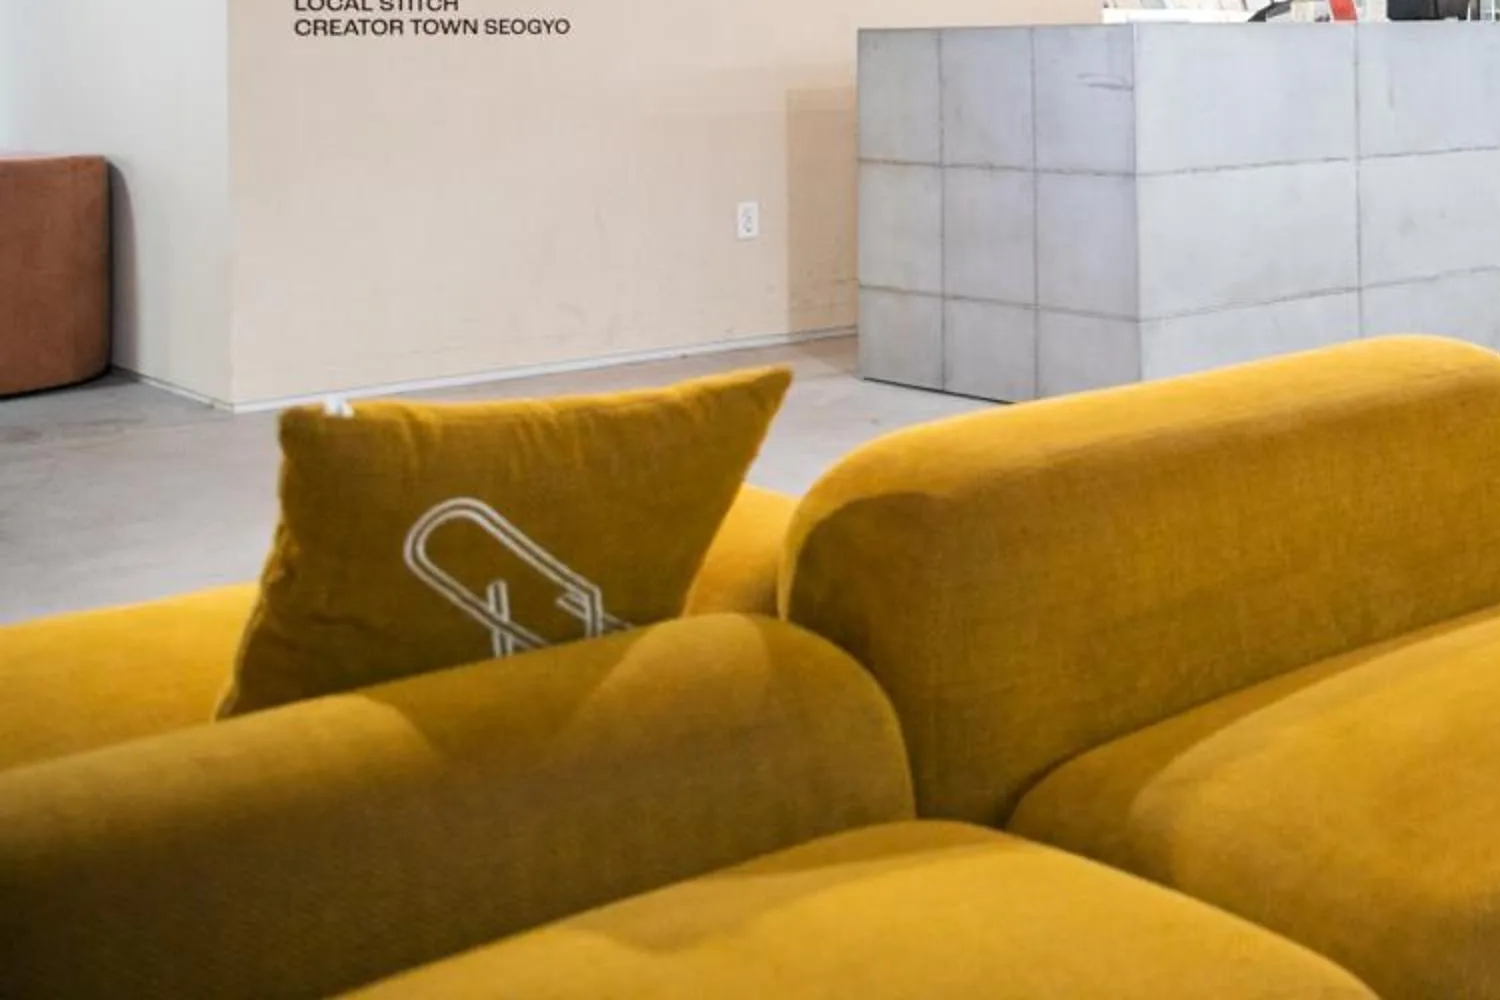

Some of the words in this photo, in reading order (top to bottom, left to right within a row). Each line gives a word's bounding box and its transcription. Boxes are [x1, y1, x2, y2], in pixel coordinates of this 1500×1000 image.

[294, 18, 404, 37] CREATOR
[410, 18, 479, 36] TOWN
[484, 18, 572, 36] SEOGYO
